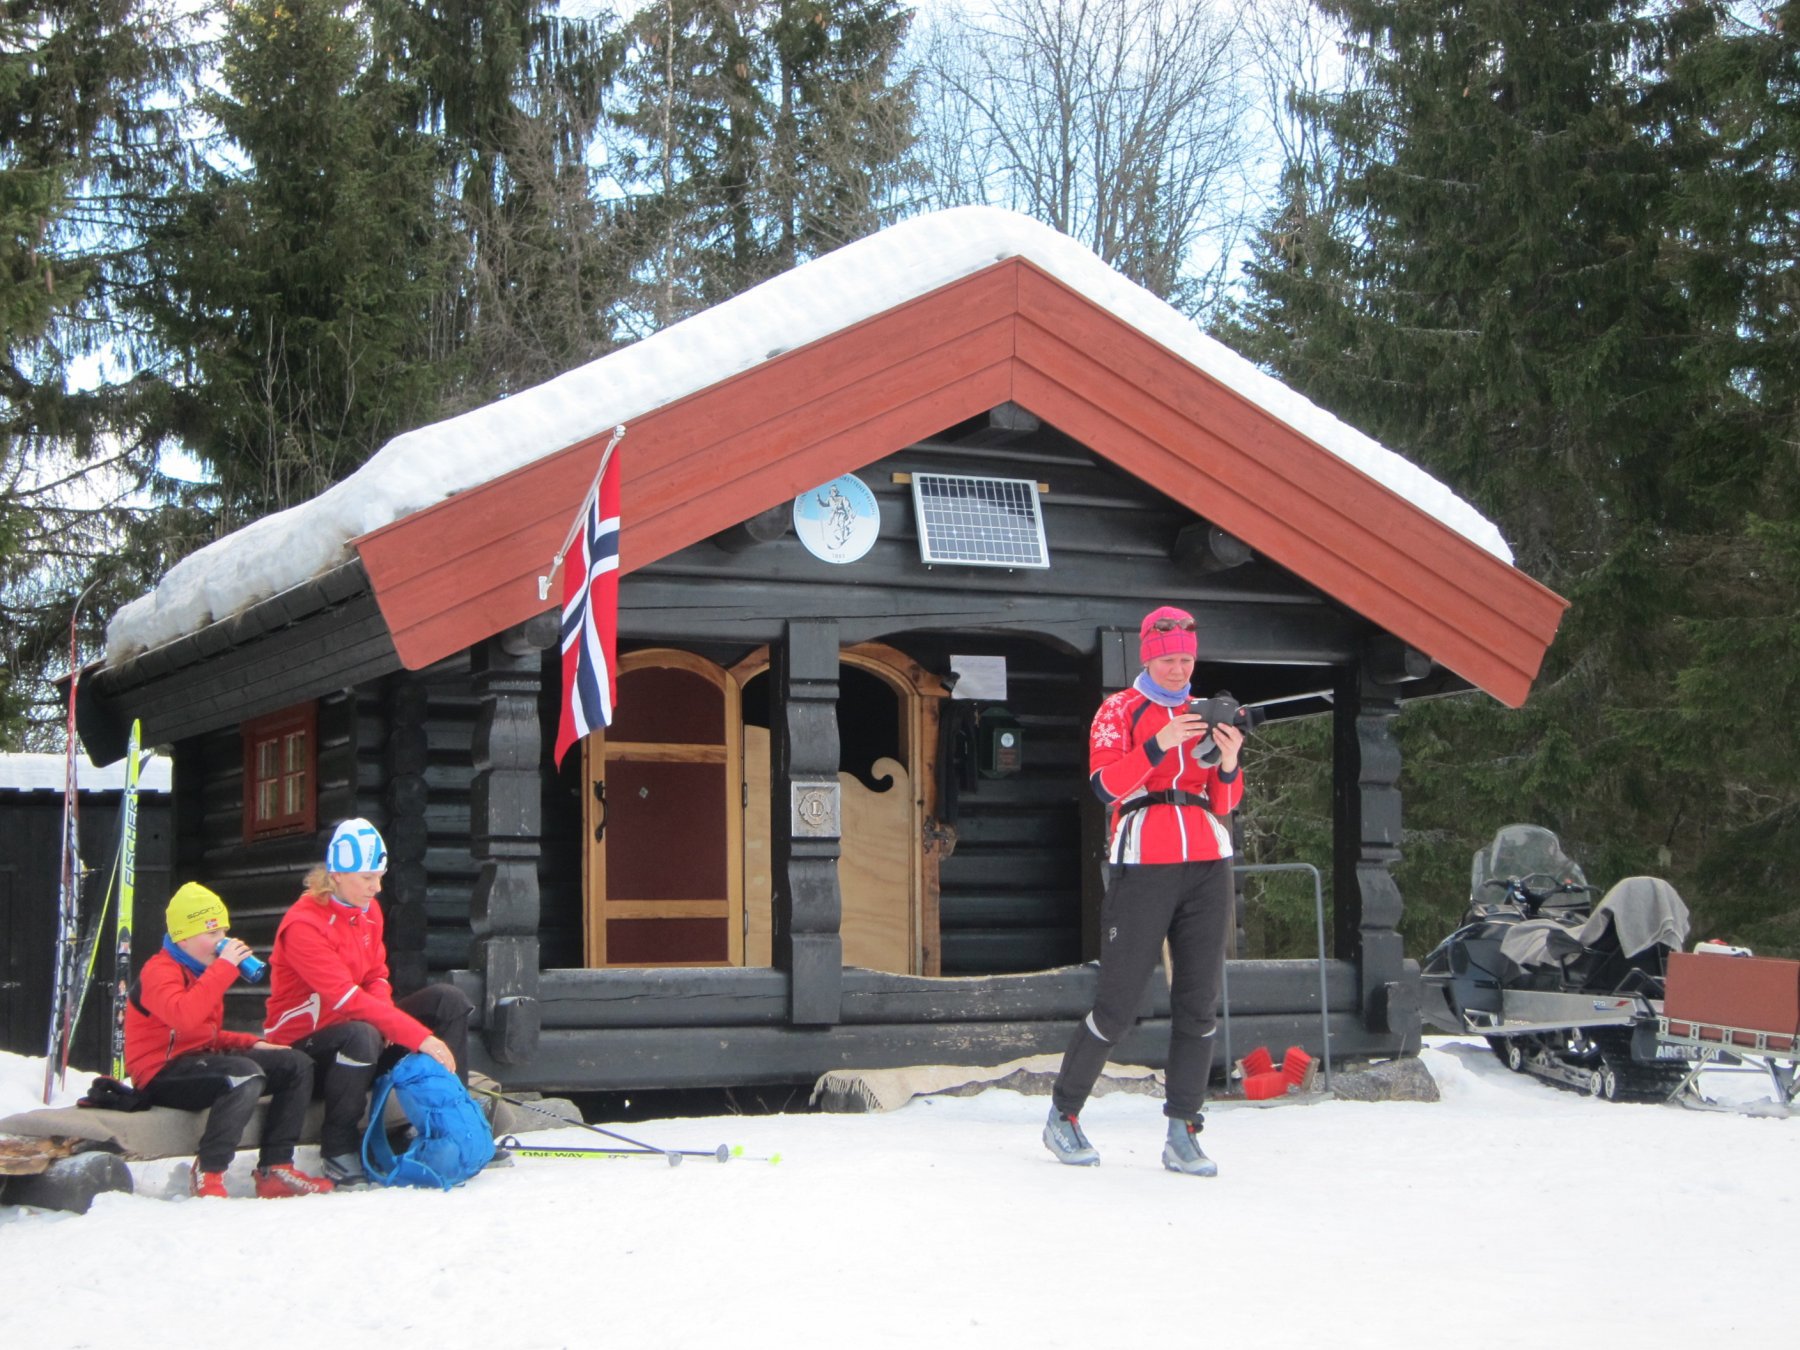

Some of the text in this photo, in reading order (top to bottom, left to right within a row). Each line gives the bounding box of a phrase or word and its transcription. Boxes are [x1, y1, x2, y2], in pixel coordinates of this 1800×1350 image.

[124, 797, 138, 888] FISCHER
[1655, 1044, 1698, 1059] ARCTIC
[554, 1151, 584, 1159] WAY
